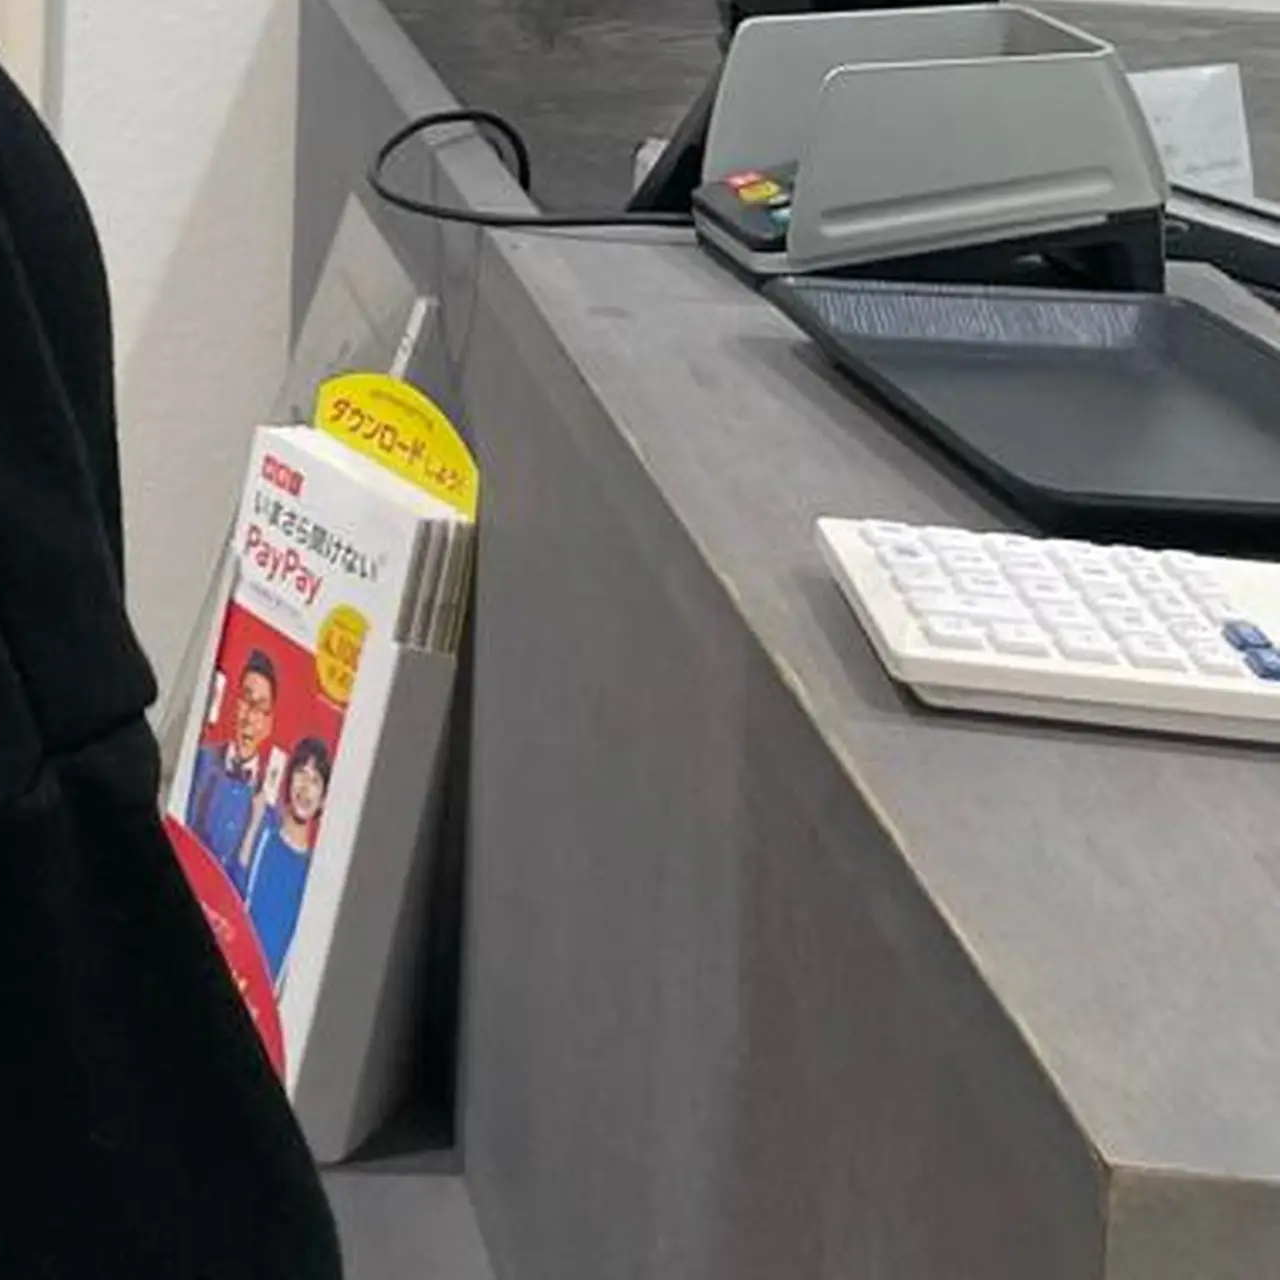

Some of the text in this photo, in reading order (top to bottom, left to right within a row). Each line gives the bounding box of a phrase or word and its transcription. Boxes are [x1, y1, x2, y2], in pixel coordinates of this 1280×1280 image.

[329, 397, 426, 465] ダウンロード
[244, 523, 325, 605] PayPay
